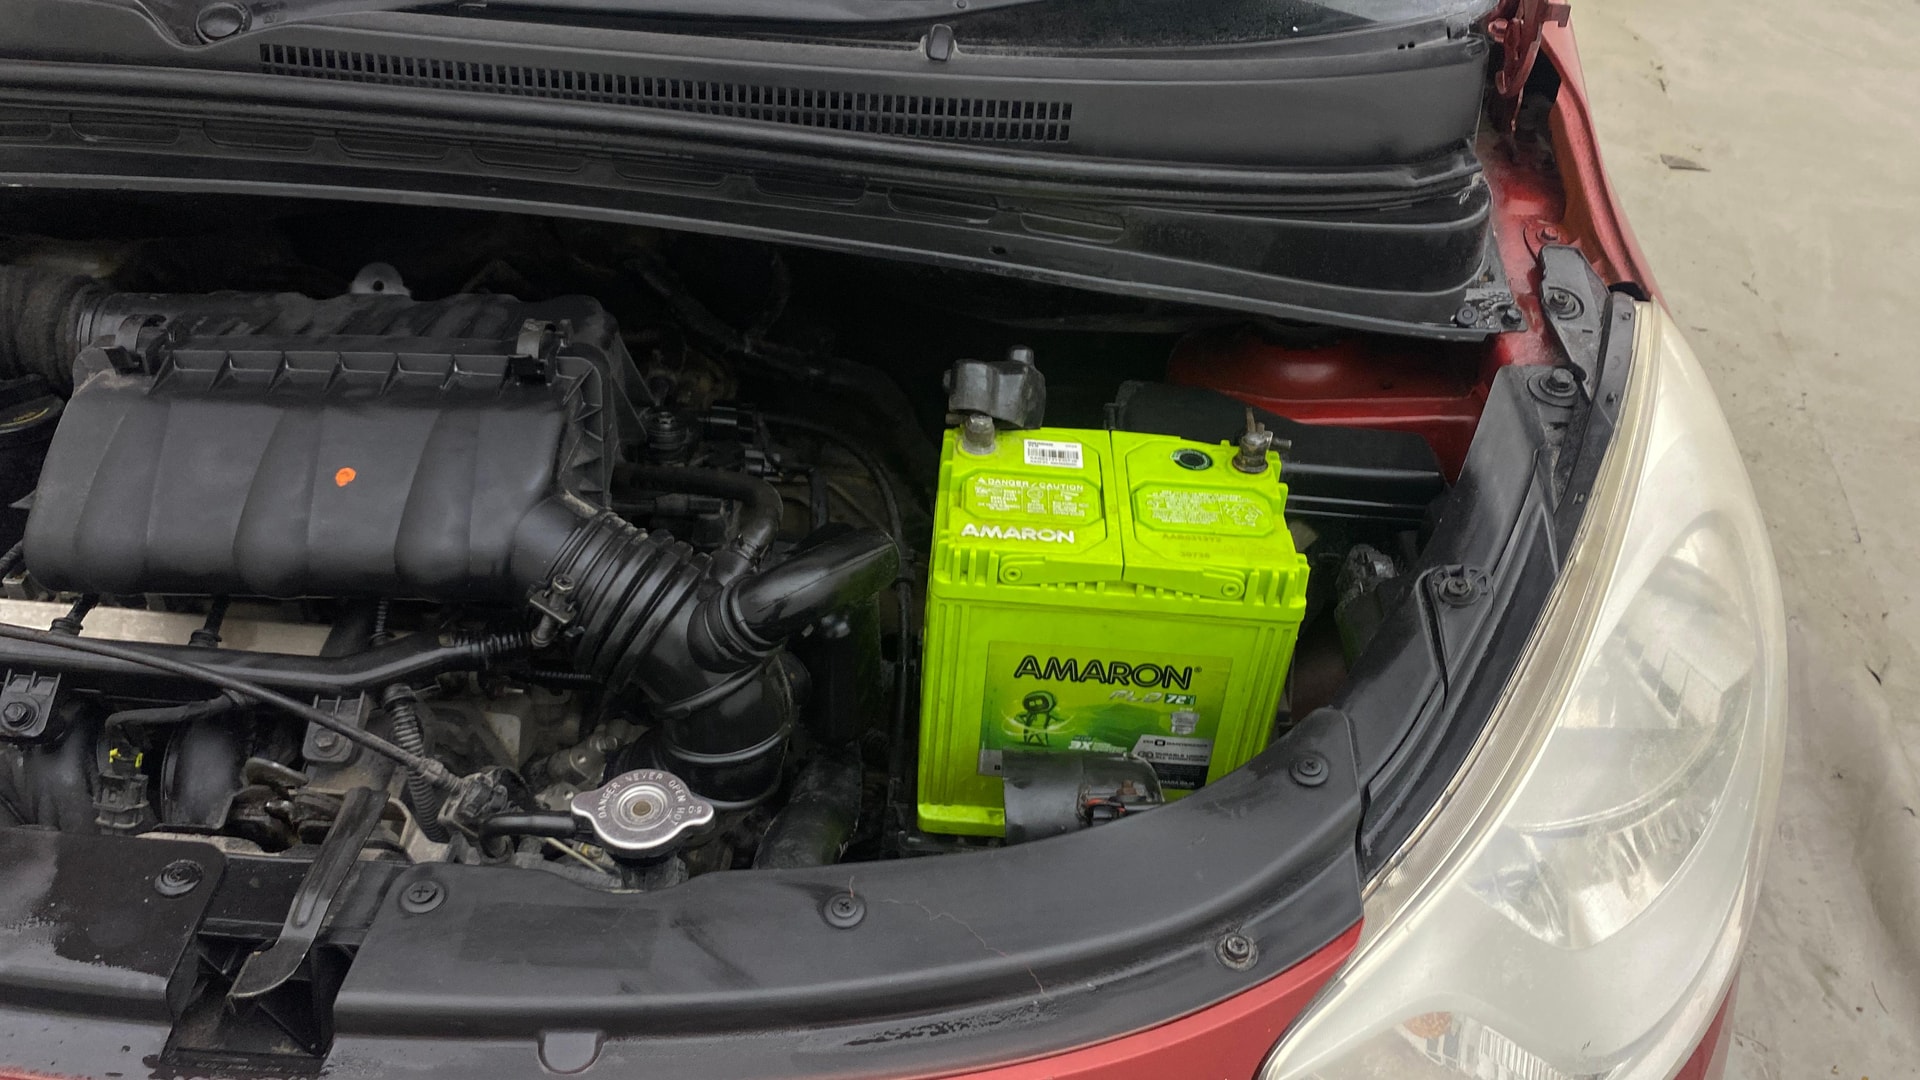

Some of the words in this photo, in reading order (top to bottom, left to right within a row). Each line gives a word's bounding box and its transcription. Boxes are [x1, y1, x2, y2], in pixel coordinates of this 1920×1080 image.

[987, 478, 1029, 488] DANGER
[1038, 482, 1084, 491] CAUTION
[961, 523, 1075, 544] AMARON
[625, 771, 663, 782] NEVER
[597, 782, 621, 819] DANGER
[668, 780, 687, 803] OPEN
[670, 806, 686, 826] HOT
